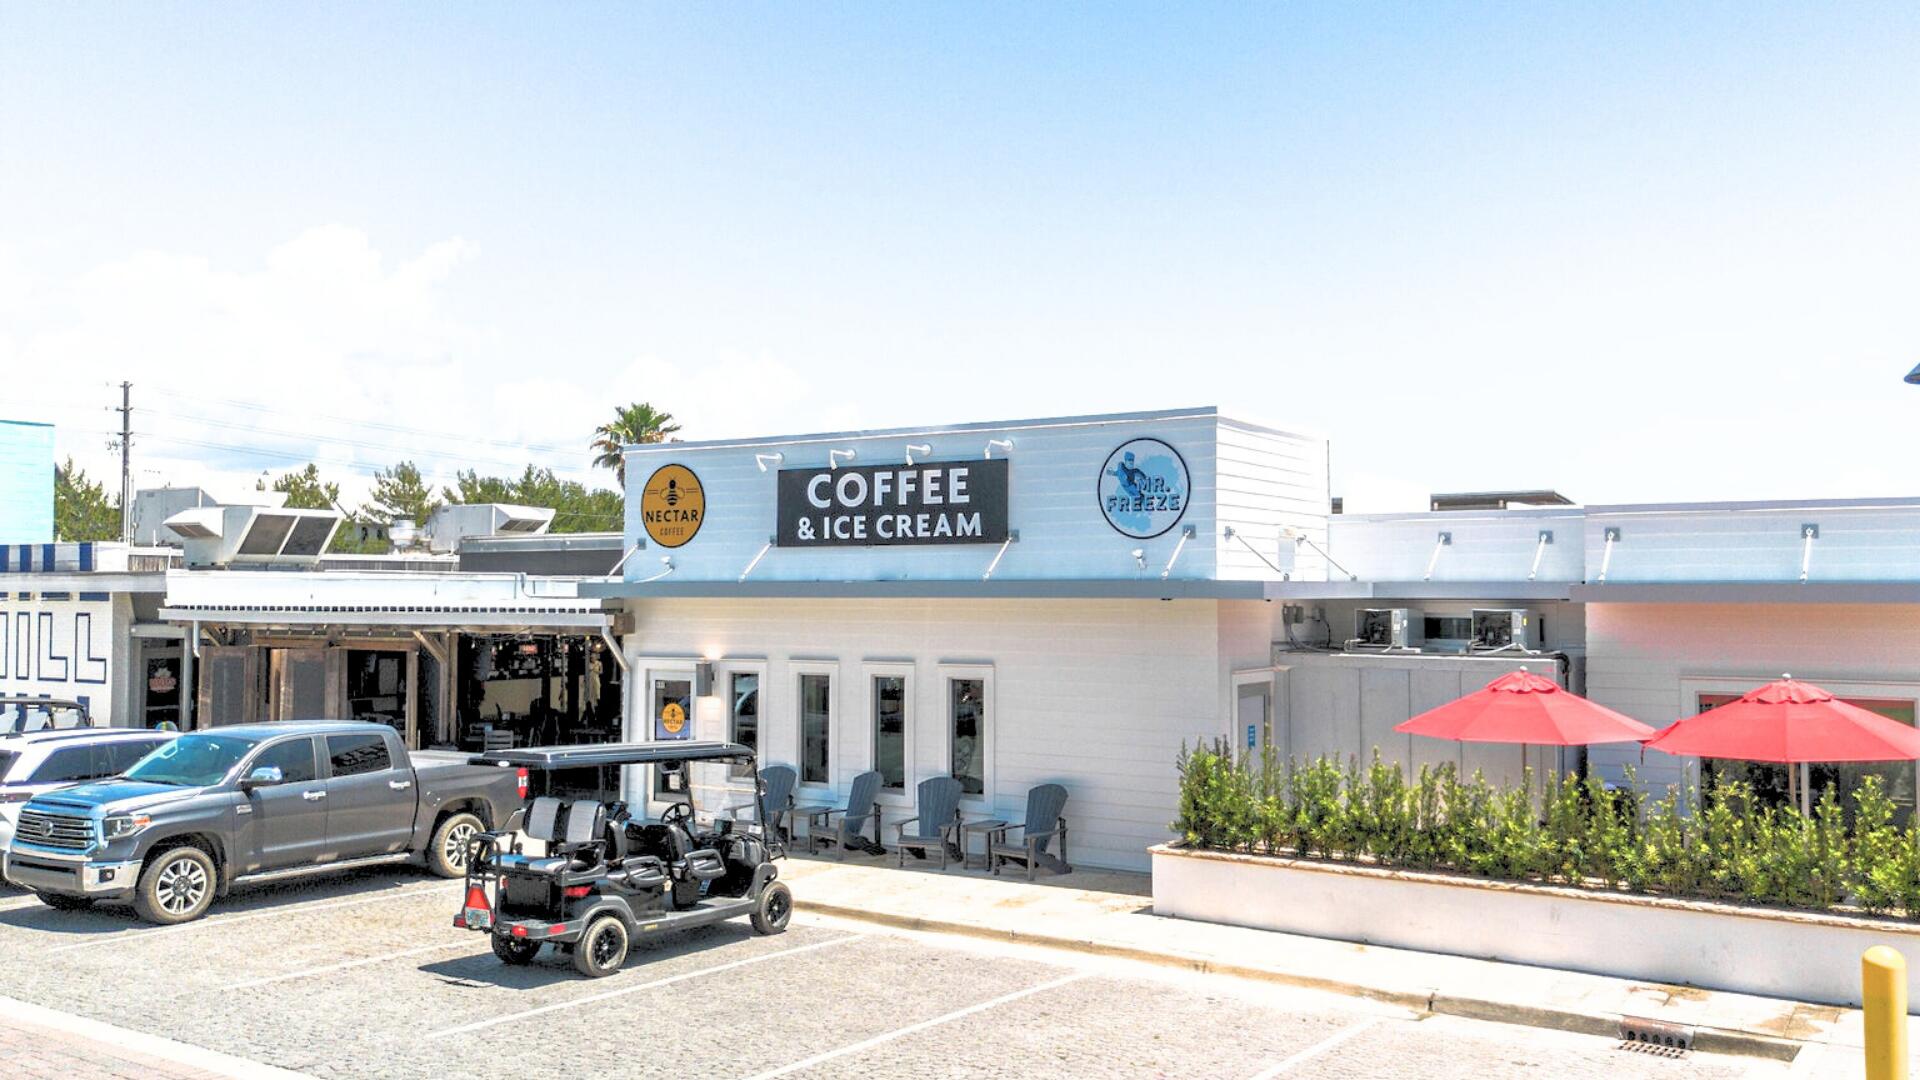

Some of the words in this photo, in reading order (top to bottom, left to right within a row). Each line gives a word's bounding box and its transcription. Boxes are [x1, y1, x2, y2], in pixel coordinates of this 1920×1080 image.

[807, 468, 970, 508] COFFEE
[1136, 476, 1171, 493] MR.
[1106, 493, 1180, 512] FREEZE
[645, 509, 699, 522] NECTAR
[660, 527, 684, 536] COFFEE
[797, 516, 816, 540] &
[823, 515, 867, 540] ICE
[876, 512, 982, 538] CREAM
[0, 611, 107, 684] ILL
